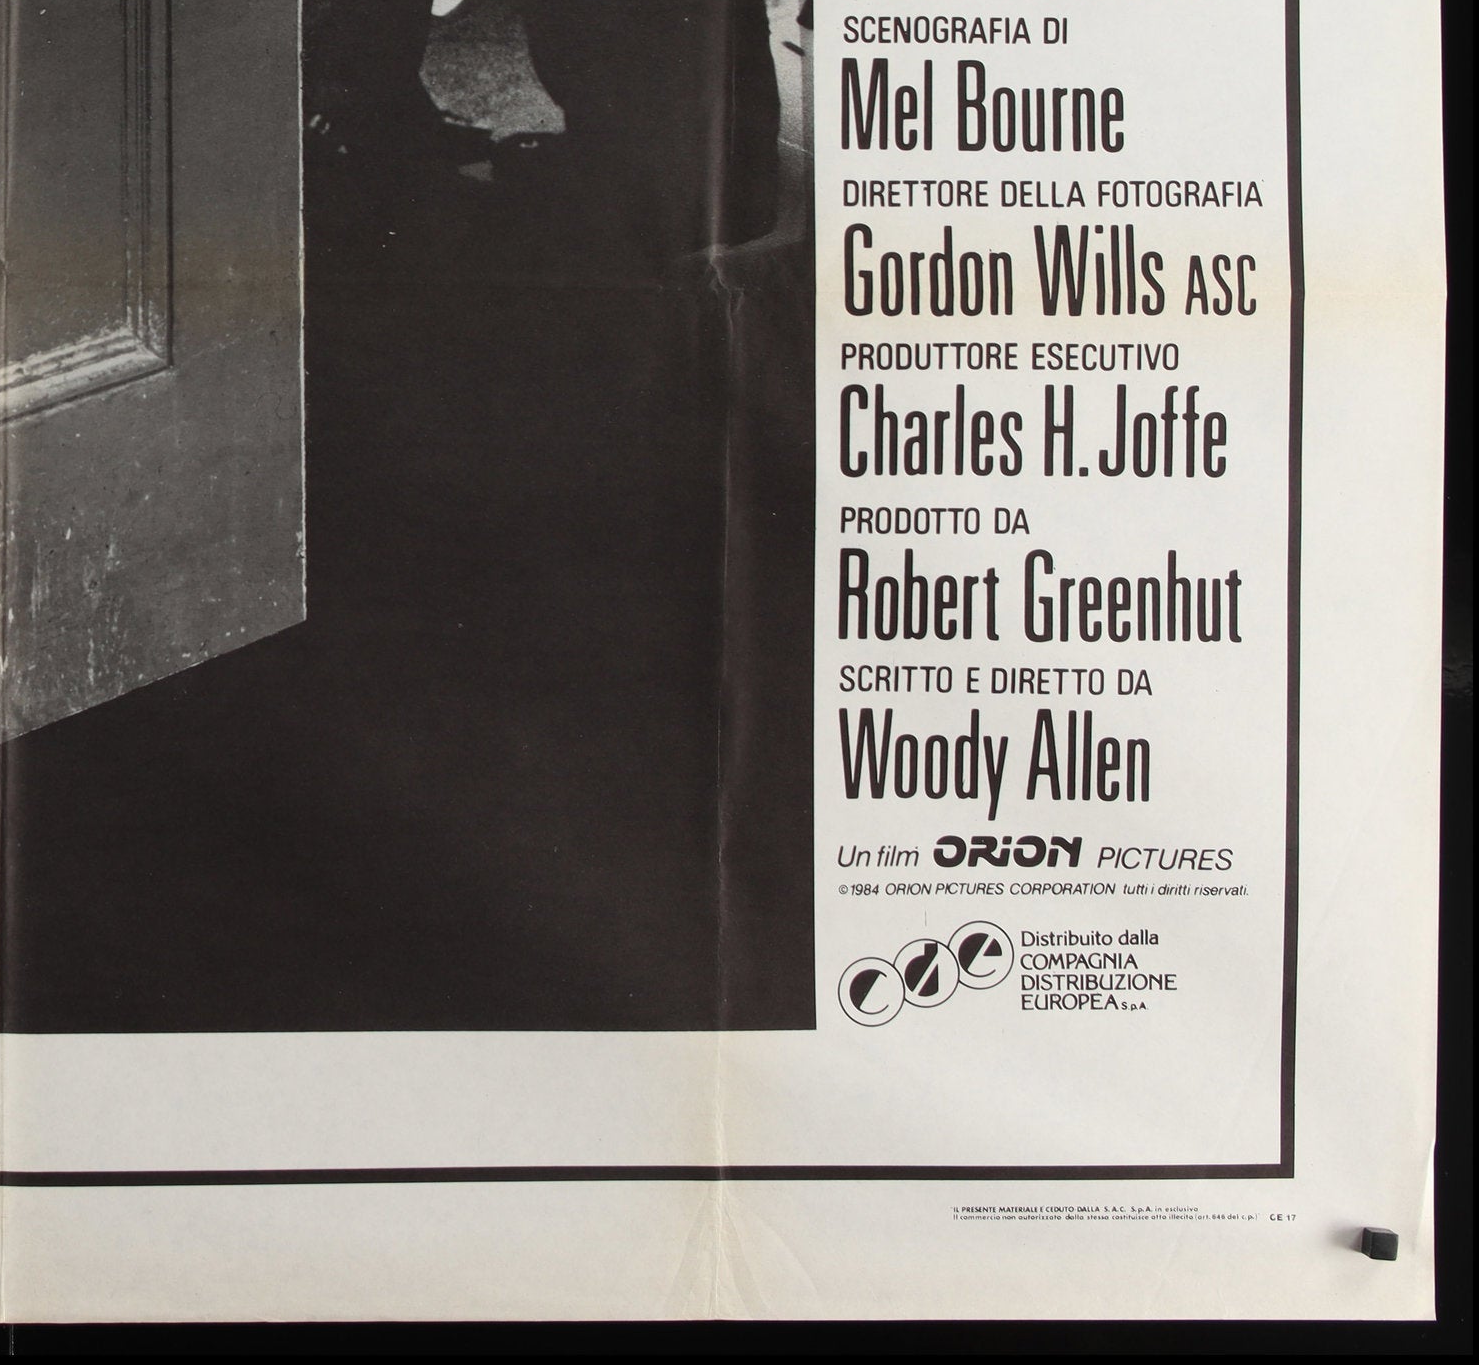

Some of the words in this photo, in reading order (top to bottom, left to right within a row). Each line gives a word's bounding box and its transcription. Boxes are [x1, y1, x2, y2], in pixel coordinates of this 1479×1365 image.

[844, 16, 1031, 44] SCENOGRAFIA
[1044, 18, 1067, 44] DI
[842, 58, 932, 151] Mel
[958, 60, 1124, 153] Bourne
[844, 180, 988, 207] DIRETTORE
[1001, 181, 1085, 207] DELLA
[1098, 180, 1263, 207] FOTOGRAFIA
[844, 223, 1013, 317] Gordon
[1034, 224, 1165, 316] Wills
[1185, 255, 1256, 316] ASC
[842, 343, 1018, 370] PRODUTTORE
[1032, 343, 1178, 371] ESECUTIVO
[840, 384, 1022, 478] Charles
[841, 507, 980, 534] PRODOTTO
[995, 508, 1029, 534] DA
[839, 548, 999, 641] Robert
[1025, 549, 1242, 642] Greenhut
[840, 665, 952, 693] SCRITTO
[967, 667, 980, 693] E
[991, 668, 1104, 695] DIRETTO
[1118, 669, 1152, 695] DA
[839, 708, 1008, 821] Woody
[1027, 709, 1150, 802] Allen
[838, 846, 870, 867] Un
[877, 846, 919, 867] film
[1098, 847, 1233, 870] PICTURES
[885, 883, 932, 896] ORION
[935, 882, 1004, 896] PICTURES
[1009, 883, 1116, 896] CORPORATION
[1123, 883, 1148, 896] tutti
[1150, 884, 1155, 896] i
[1158, 884, 1191, 896] diritti
[1022, 930, 1112, 946] Distribuito
[1118, 929, 1158, 945] dalla
[1021, 953, 1138, 970] COMPAGNIA
[1021, 974, 1177, 990] DISTRIBUZIONE
[1022, 993, 1118, 1010] EUROPEA
